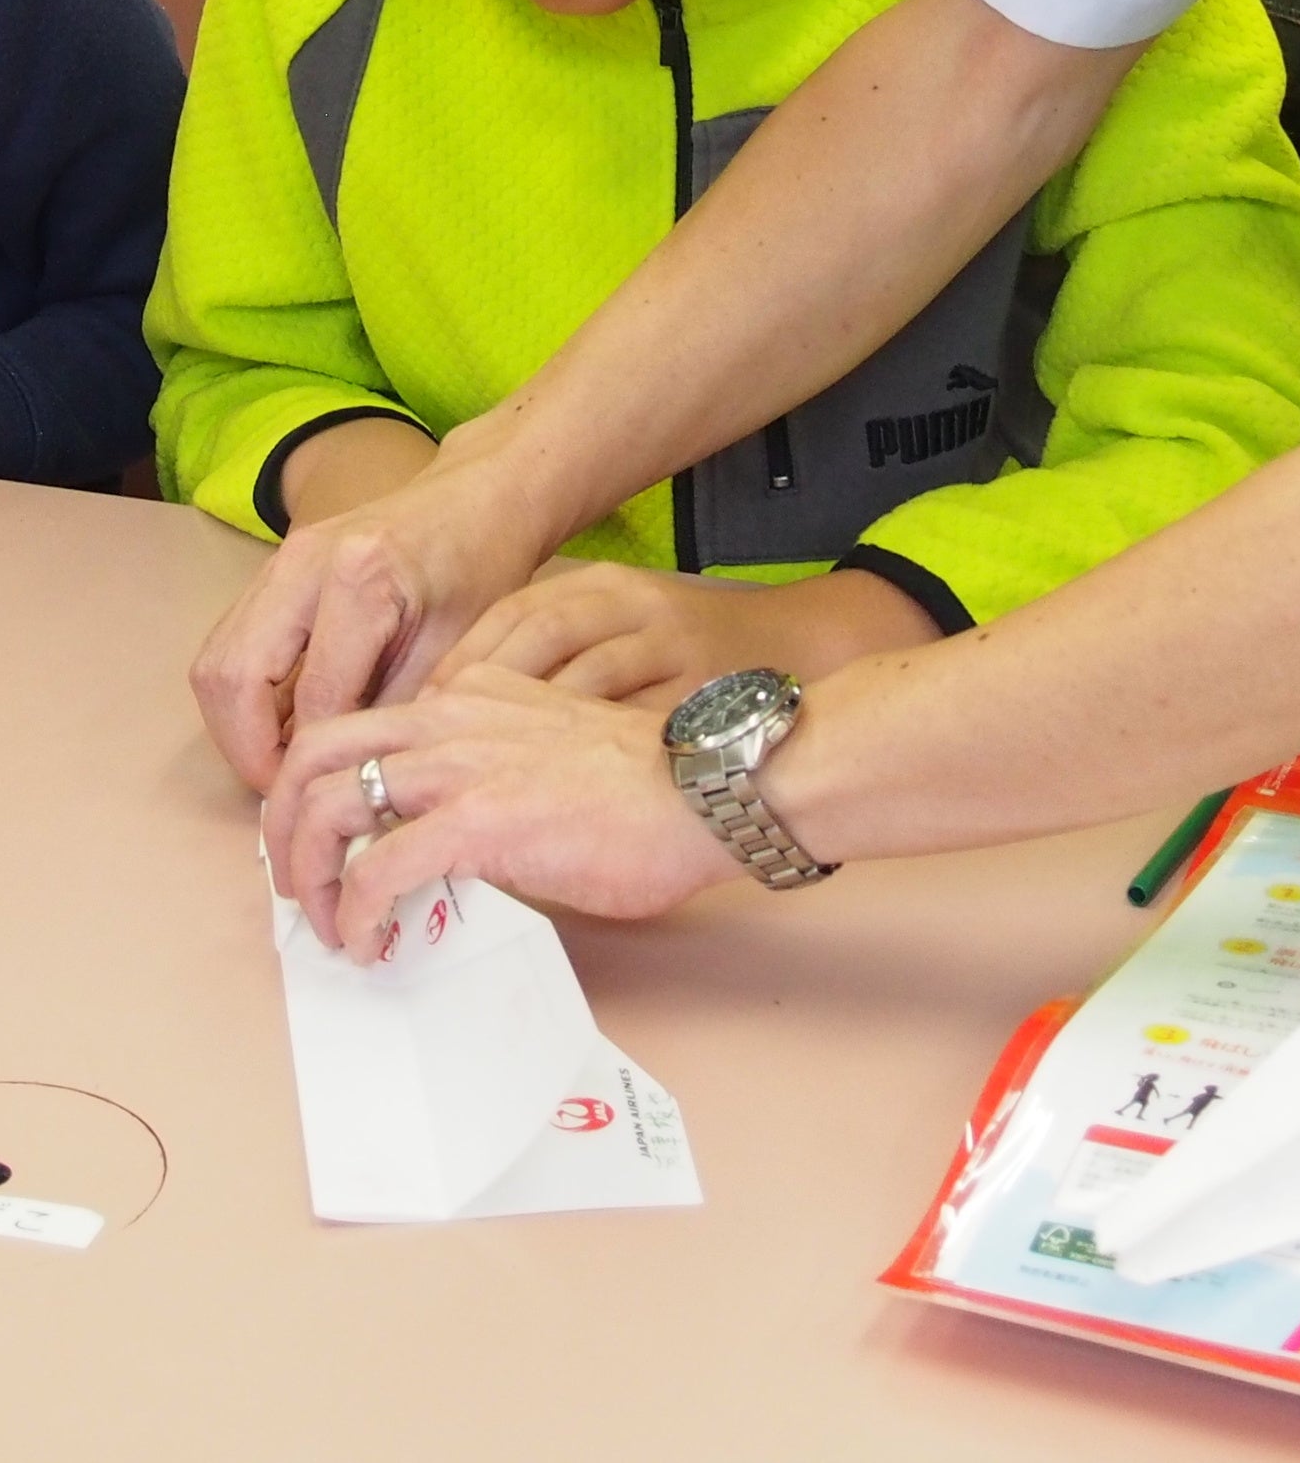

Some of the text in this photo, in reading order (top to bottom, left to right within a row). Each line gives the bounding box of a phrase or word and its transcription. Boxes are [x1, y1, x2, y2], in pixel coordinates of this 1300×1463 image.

[865, 394, 992, 469] PUMA
[618, 1067, 653, 1159] JAPAN AIRLINES
